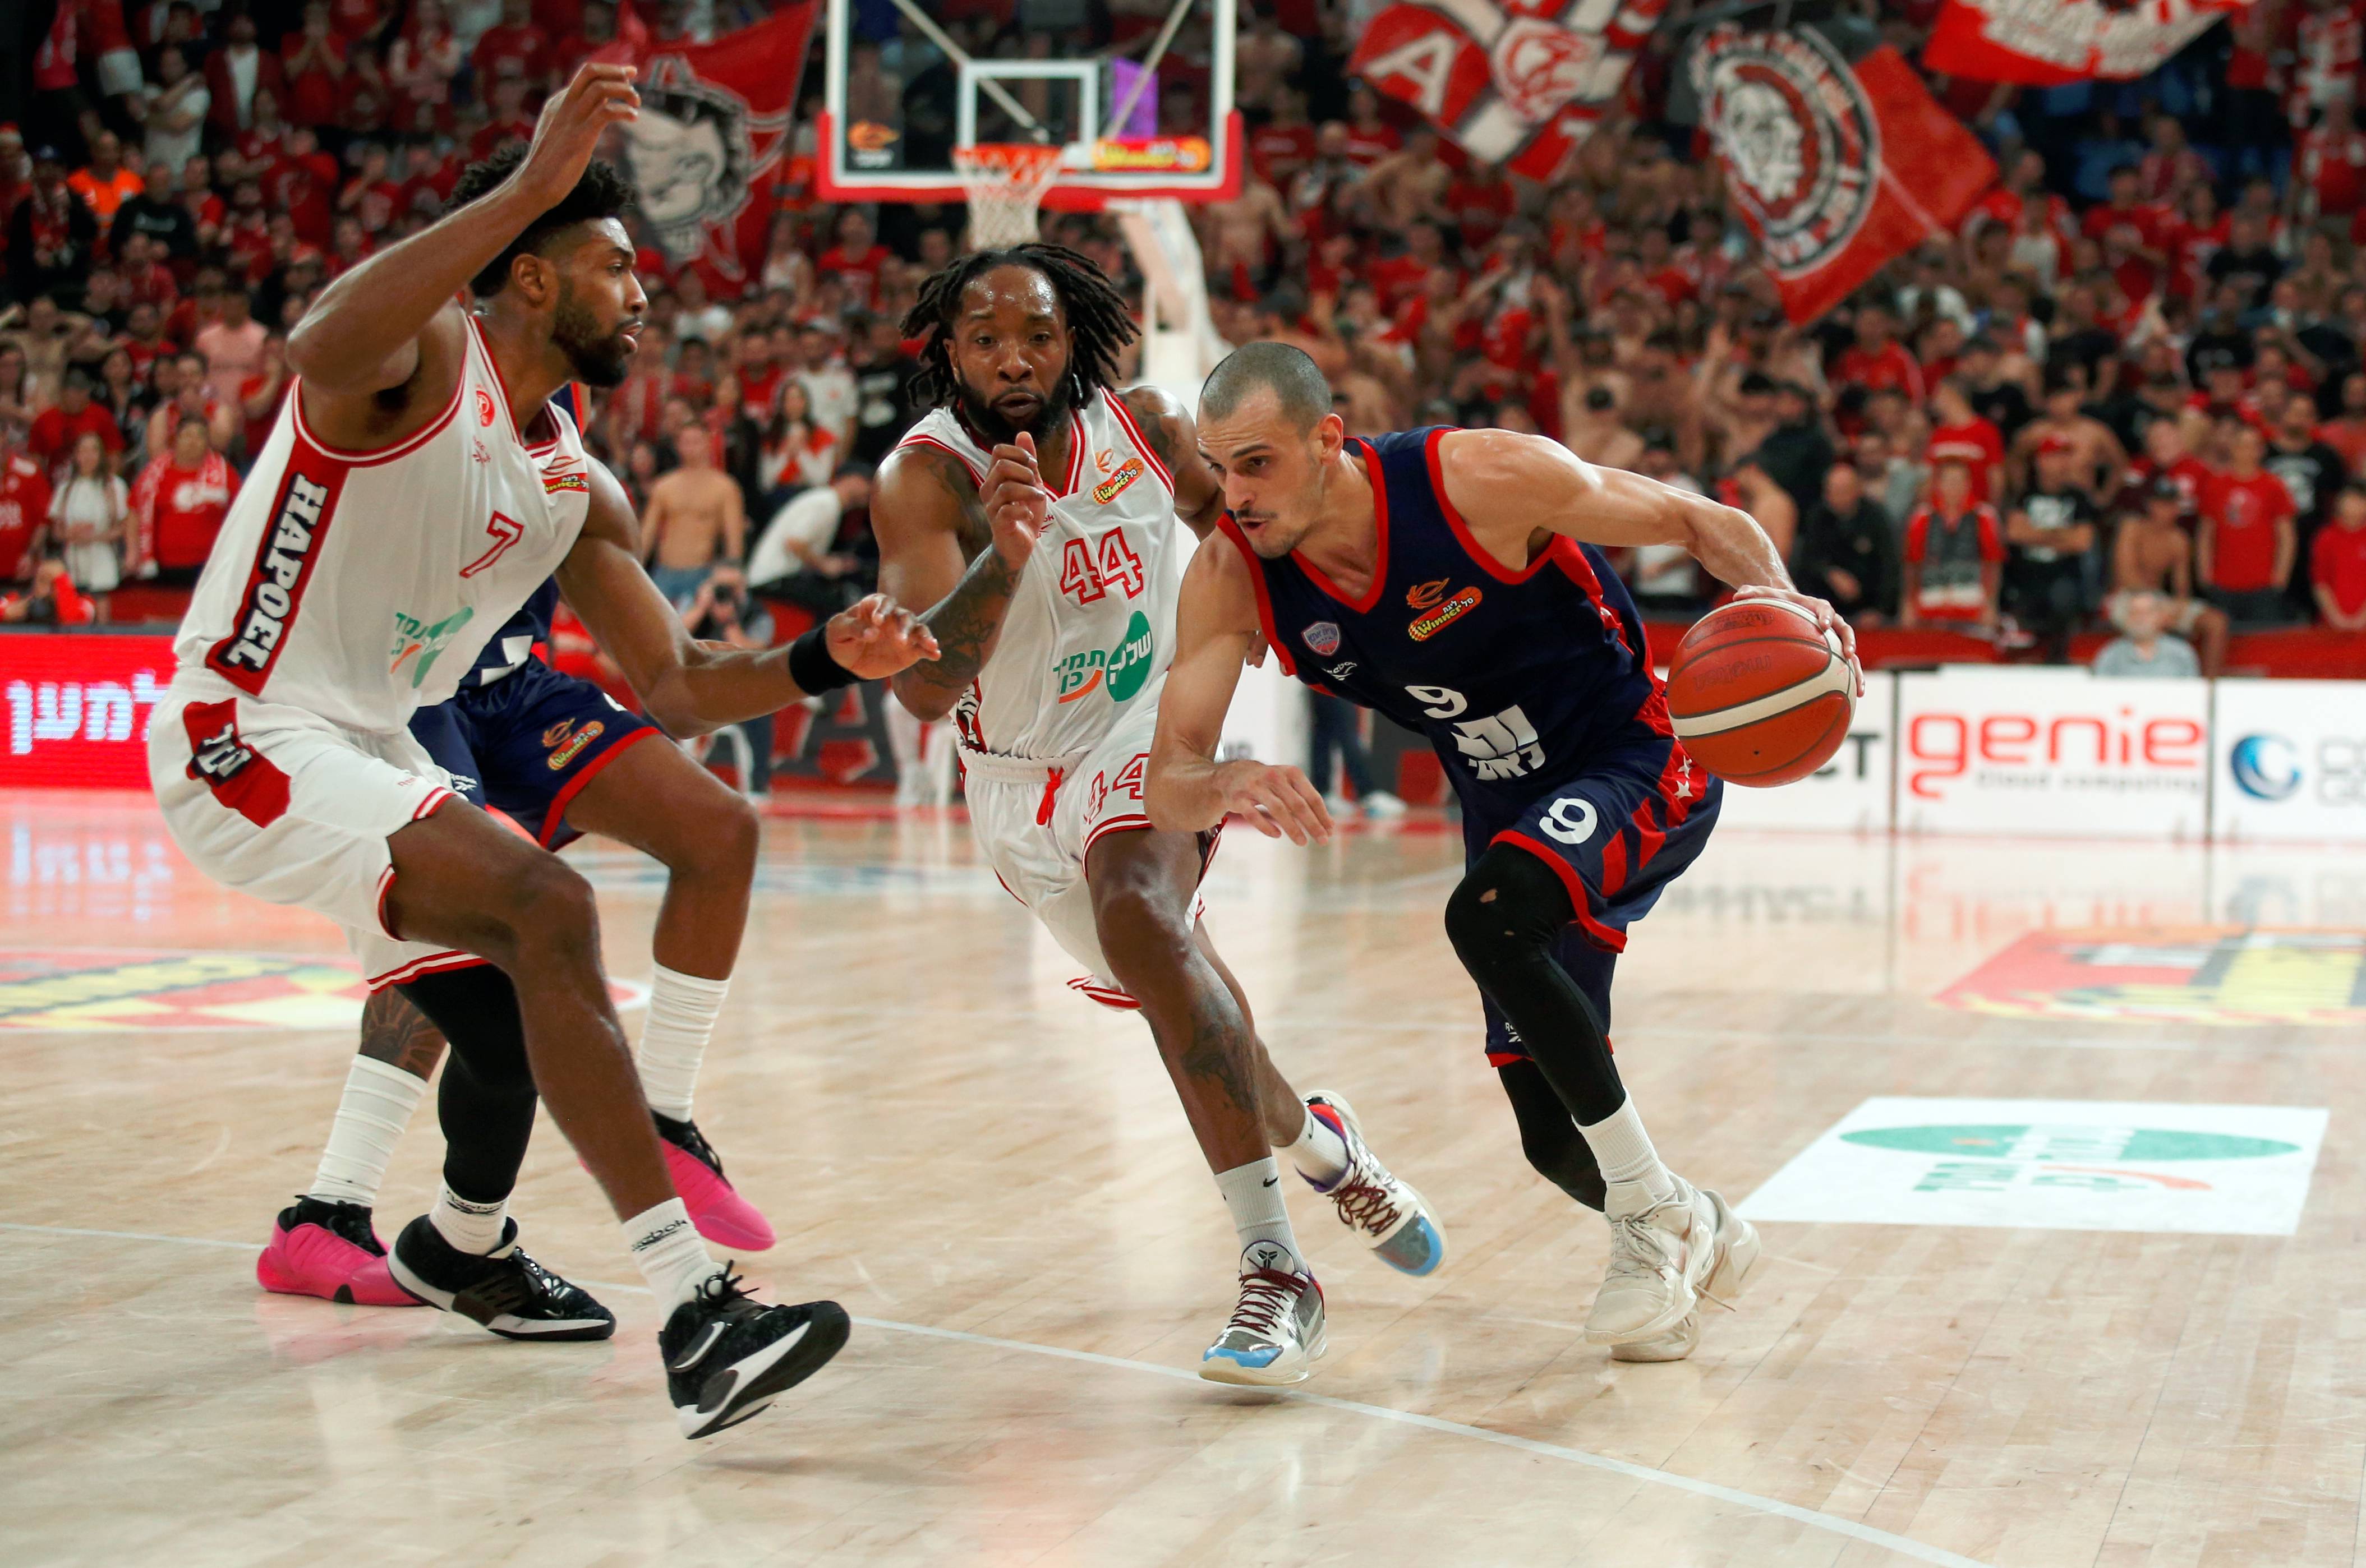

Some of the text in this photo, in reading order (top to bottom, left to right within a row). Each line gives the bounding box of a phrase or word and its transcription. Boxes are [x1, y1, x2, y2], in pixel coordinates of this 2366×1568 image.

[1099, 474, 1130, 500] Winner
[459, 510, 525, 579] 7
[1060, 526, 1144, 606] 44
[226, 472, 329, 670] HAPOEL
[1416, 597, 1474, 635] Winner סל
[1442, 600, 1458, 614] ליגת
[1060, 671, 1083, 694] כן
[1404, 685, 1468, 720] 9
[1909, 706, 2204, 799] genie
[1539, 797, 1598, 845] 9
